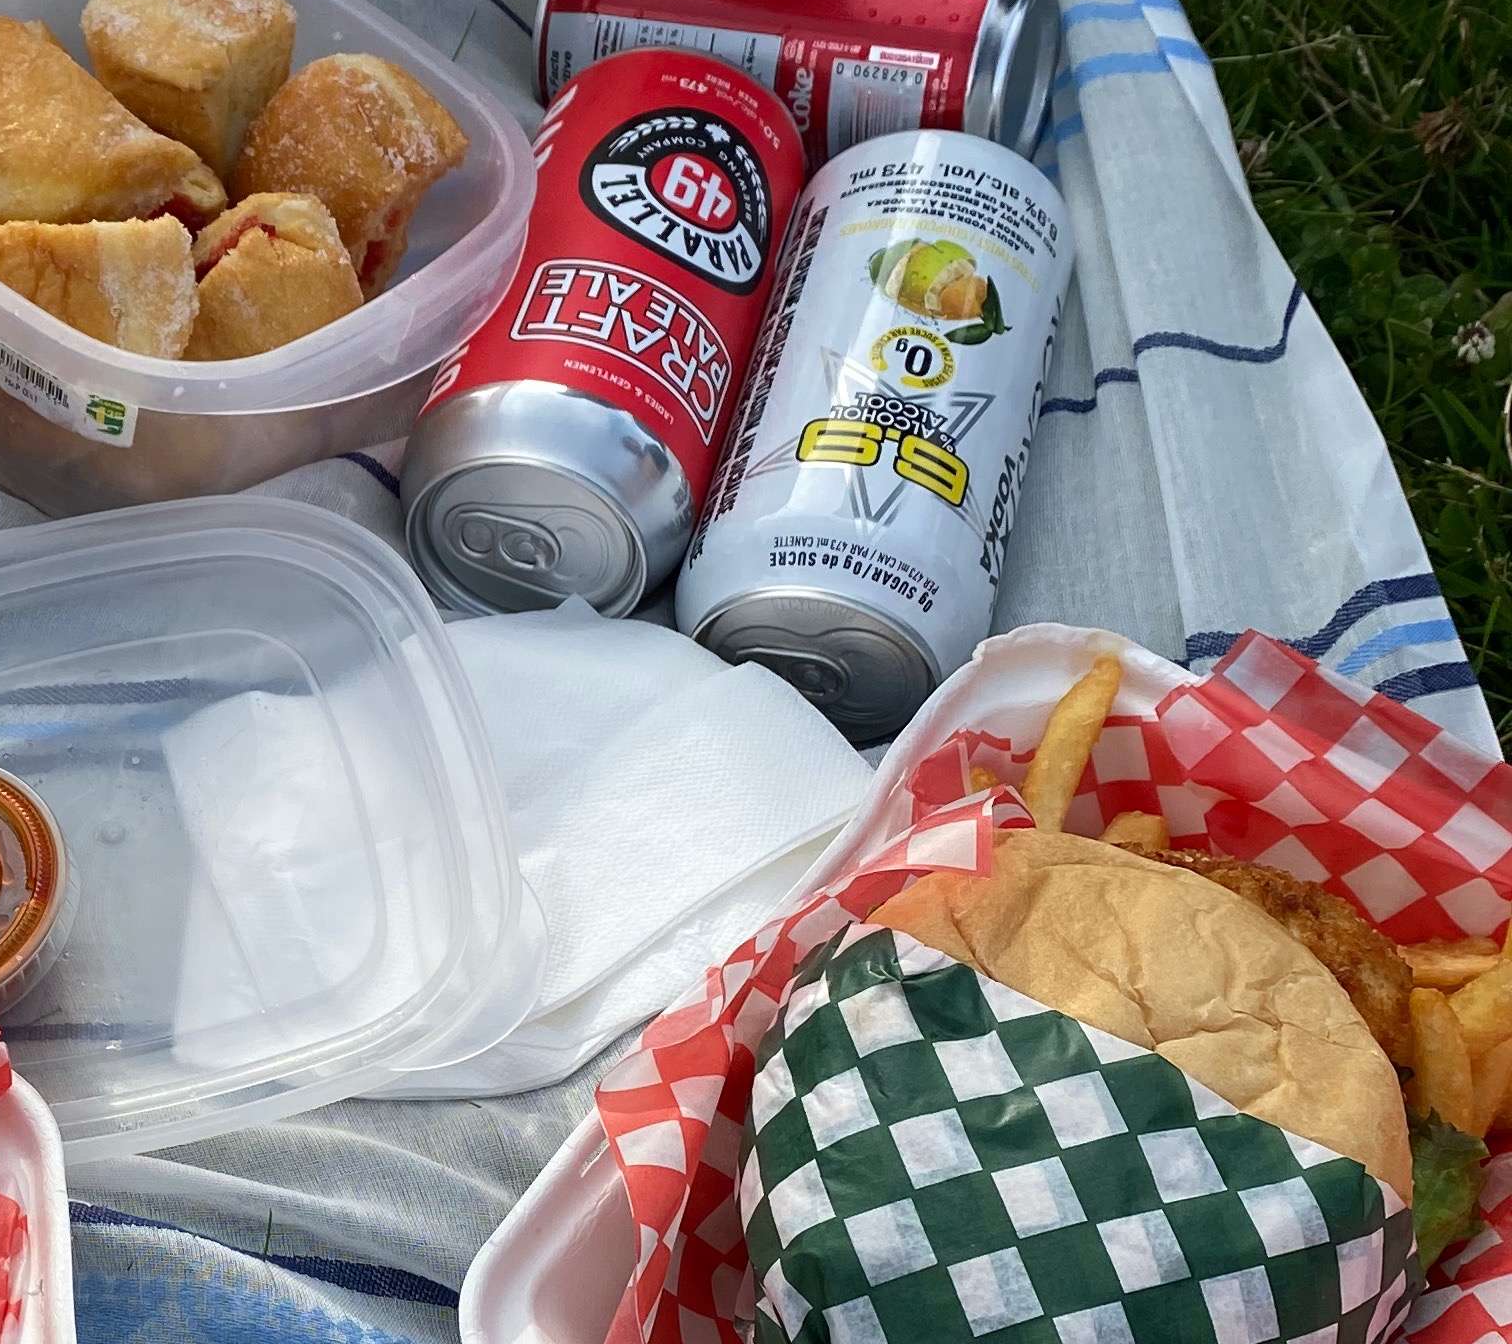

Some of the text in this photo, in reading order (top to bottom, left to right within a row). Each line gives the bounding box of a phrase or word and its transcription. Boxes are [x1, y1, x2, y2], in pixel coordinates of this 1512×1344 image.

[678, 76, 709, 94] 473
[635, 134, 752, 223] BREWING COMPANY
[881, 161, 925, 177] 473
[662, 155, 733, 222] 49
[938, 162, 1021, 200] alc./vol.
[867, 197, 906, 208] VODKA
[936, 190, 981, 208] ENERGY
[976, 191, 997, 206] UNE
[1000, 199, 1019, 217] PAS
[982, 202, 999, 215] AN
[600, 172, 754, 276] PARALLEL
[948, 211, 987, 232] VODKA
[1000, 213, 1021, 229] NOT
[990, 227, 1021, 252] ADULT
[996, 220, 1036, 255] BOISSON
[540, 268, 727, 393] PALE ALE
[526, 296, 716, 422] CRAFT
[563, 358, 675, 425] LADIES & GENTLEMEN
[854, 392, 948, 428] ALCOOL
[830, 406, 955, 453] % ALCOHOL
[796, 417, 970, 508] 6.9
[979, 454, 1018, 574] VODKA
[772, 535, 815, 549] CANETTE
[830, 539, 849, 553] 473
[851, 543, 870, 558] PAR
[769, 551, 817, 568] SUCRE
[821, 553, 839, 569] de
[876, 551, 897, 570] CAN
[906, 567, 925, 583] 473
[922, 578, 941, 596] PER
[918, 591, 934, 613] 0g
